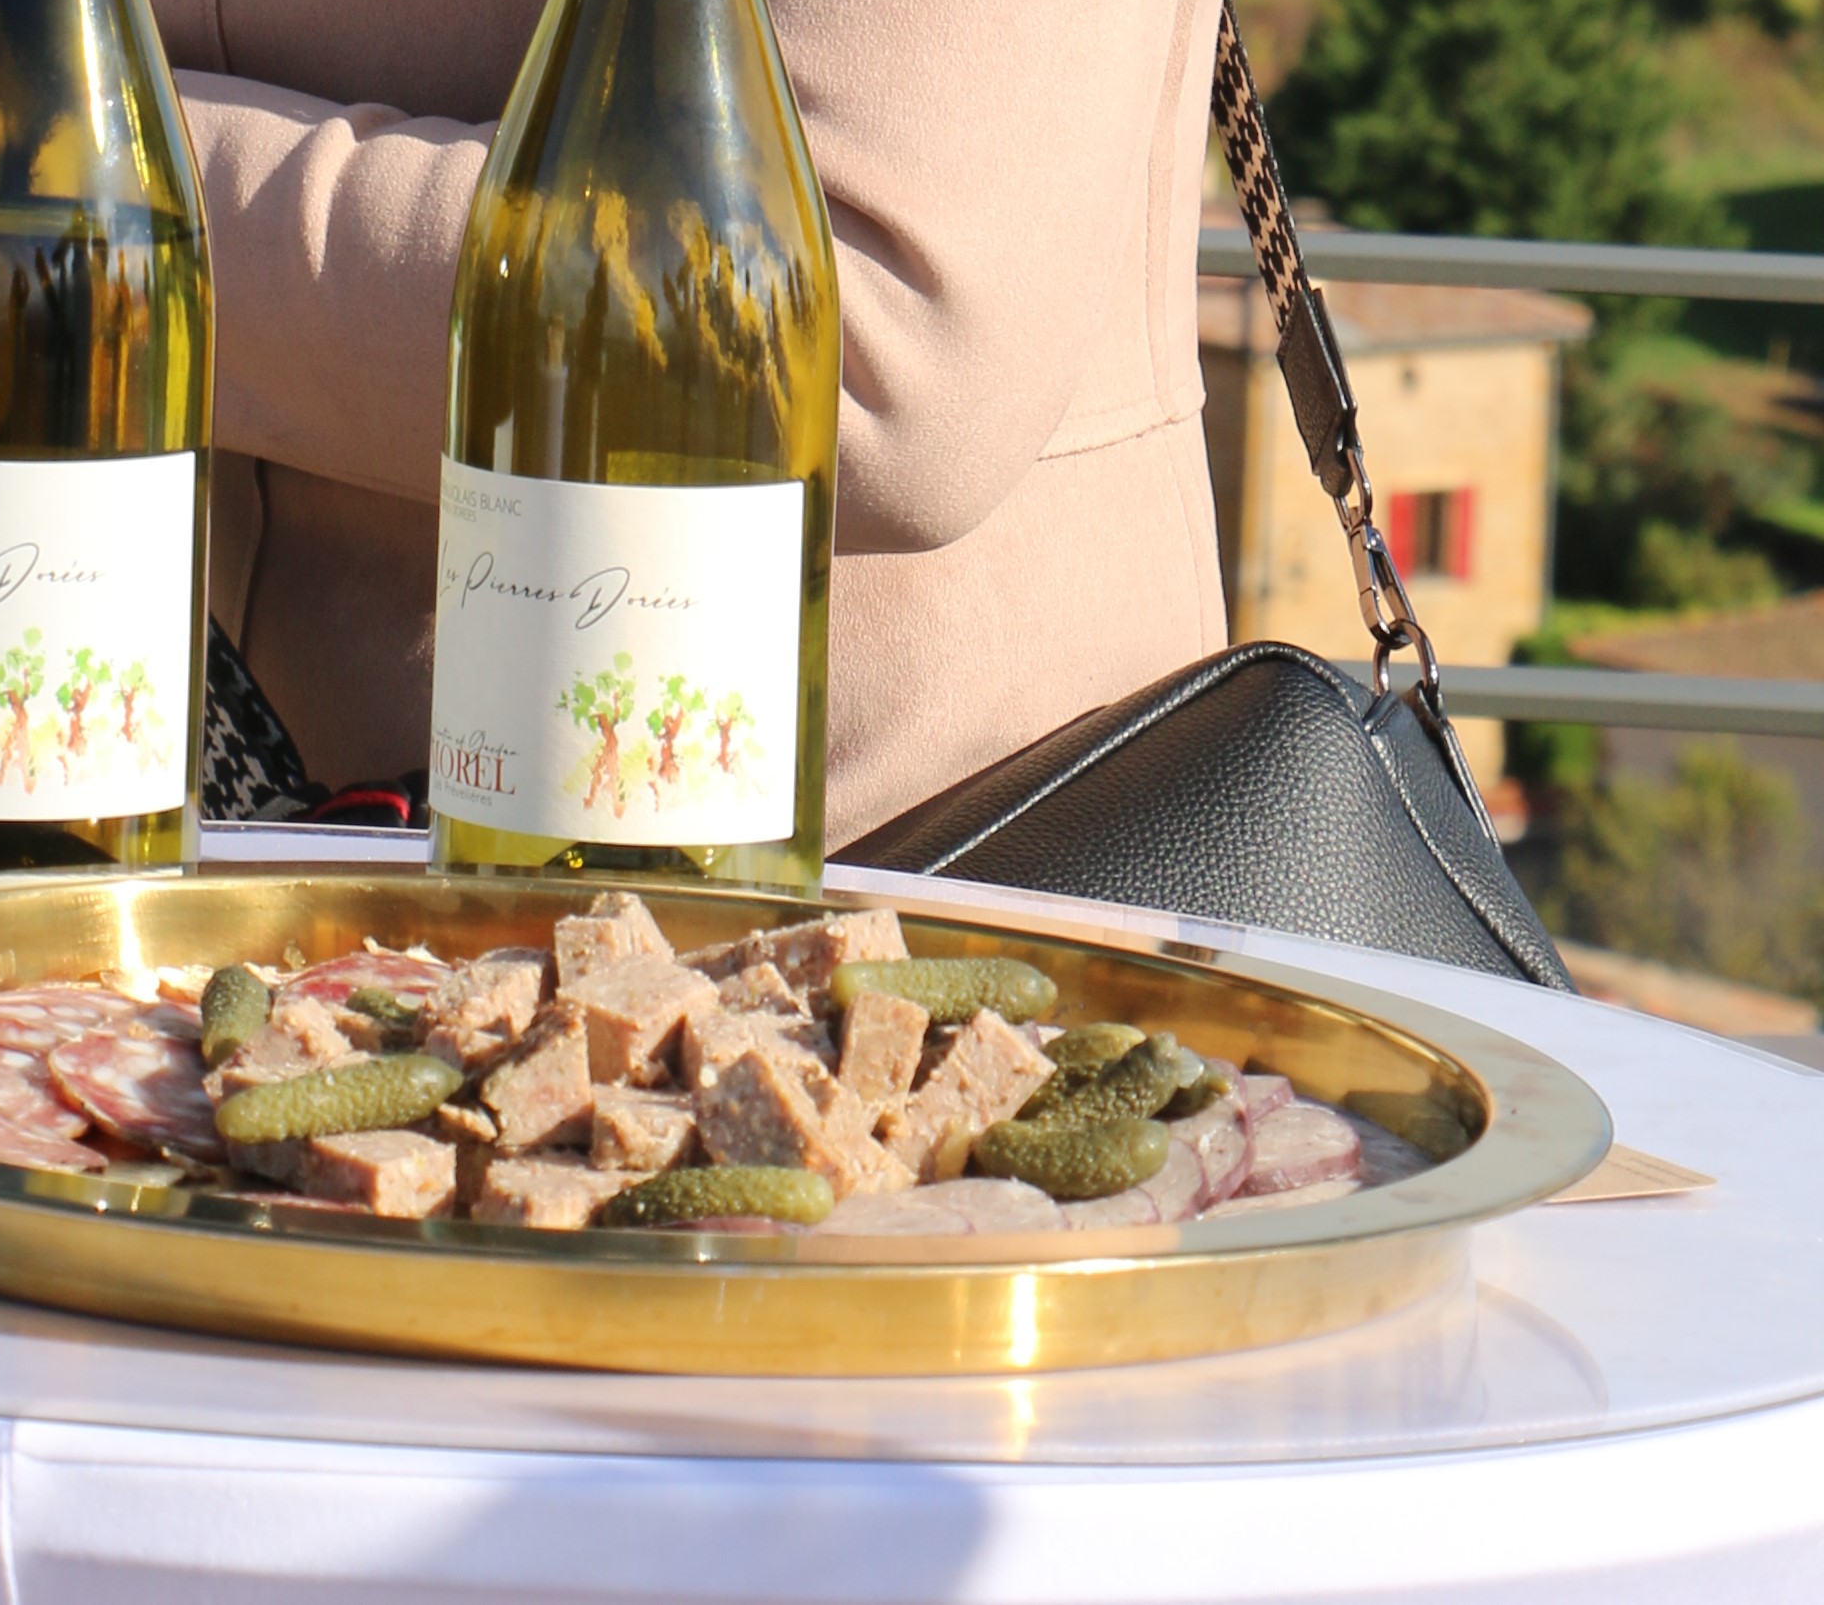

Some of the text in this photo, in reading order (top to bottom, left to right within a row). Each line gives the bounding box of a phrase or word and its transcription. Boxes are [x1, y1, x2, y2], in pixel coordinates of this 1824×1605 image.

[480, 492, 523, 517] BLANC
[460, 551, 564, 609] Pierres
[569, 566, 700, 630] Dorées
